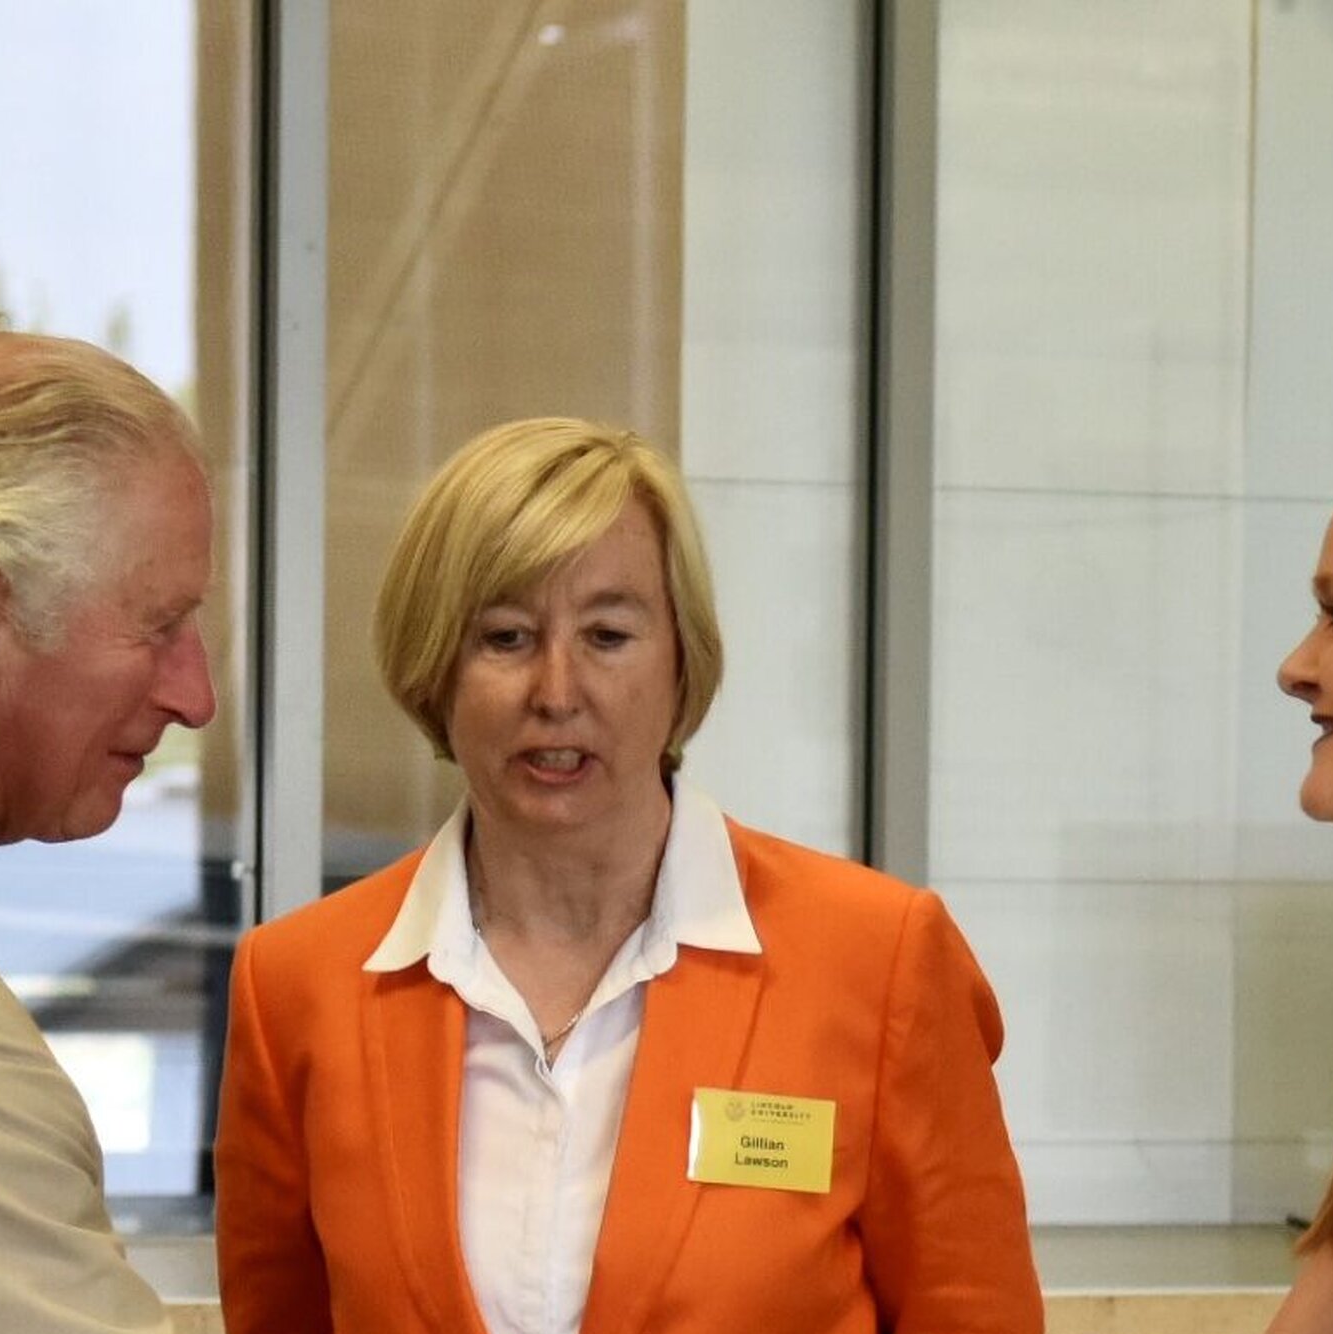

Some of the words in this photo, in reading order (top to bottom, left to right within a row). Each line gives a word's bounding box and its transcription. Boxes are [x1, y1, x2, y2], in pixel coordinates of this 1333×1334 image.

[751, 1109, 812, 1119] UNIVERSITY
[740, 1136, 785, 1151] Gillian
[735, 1152, 789, 1168] Lawson
